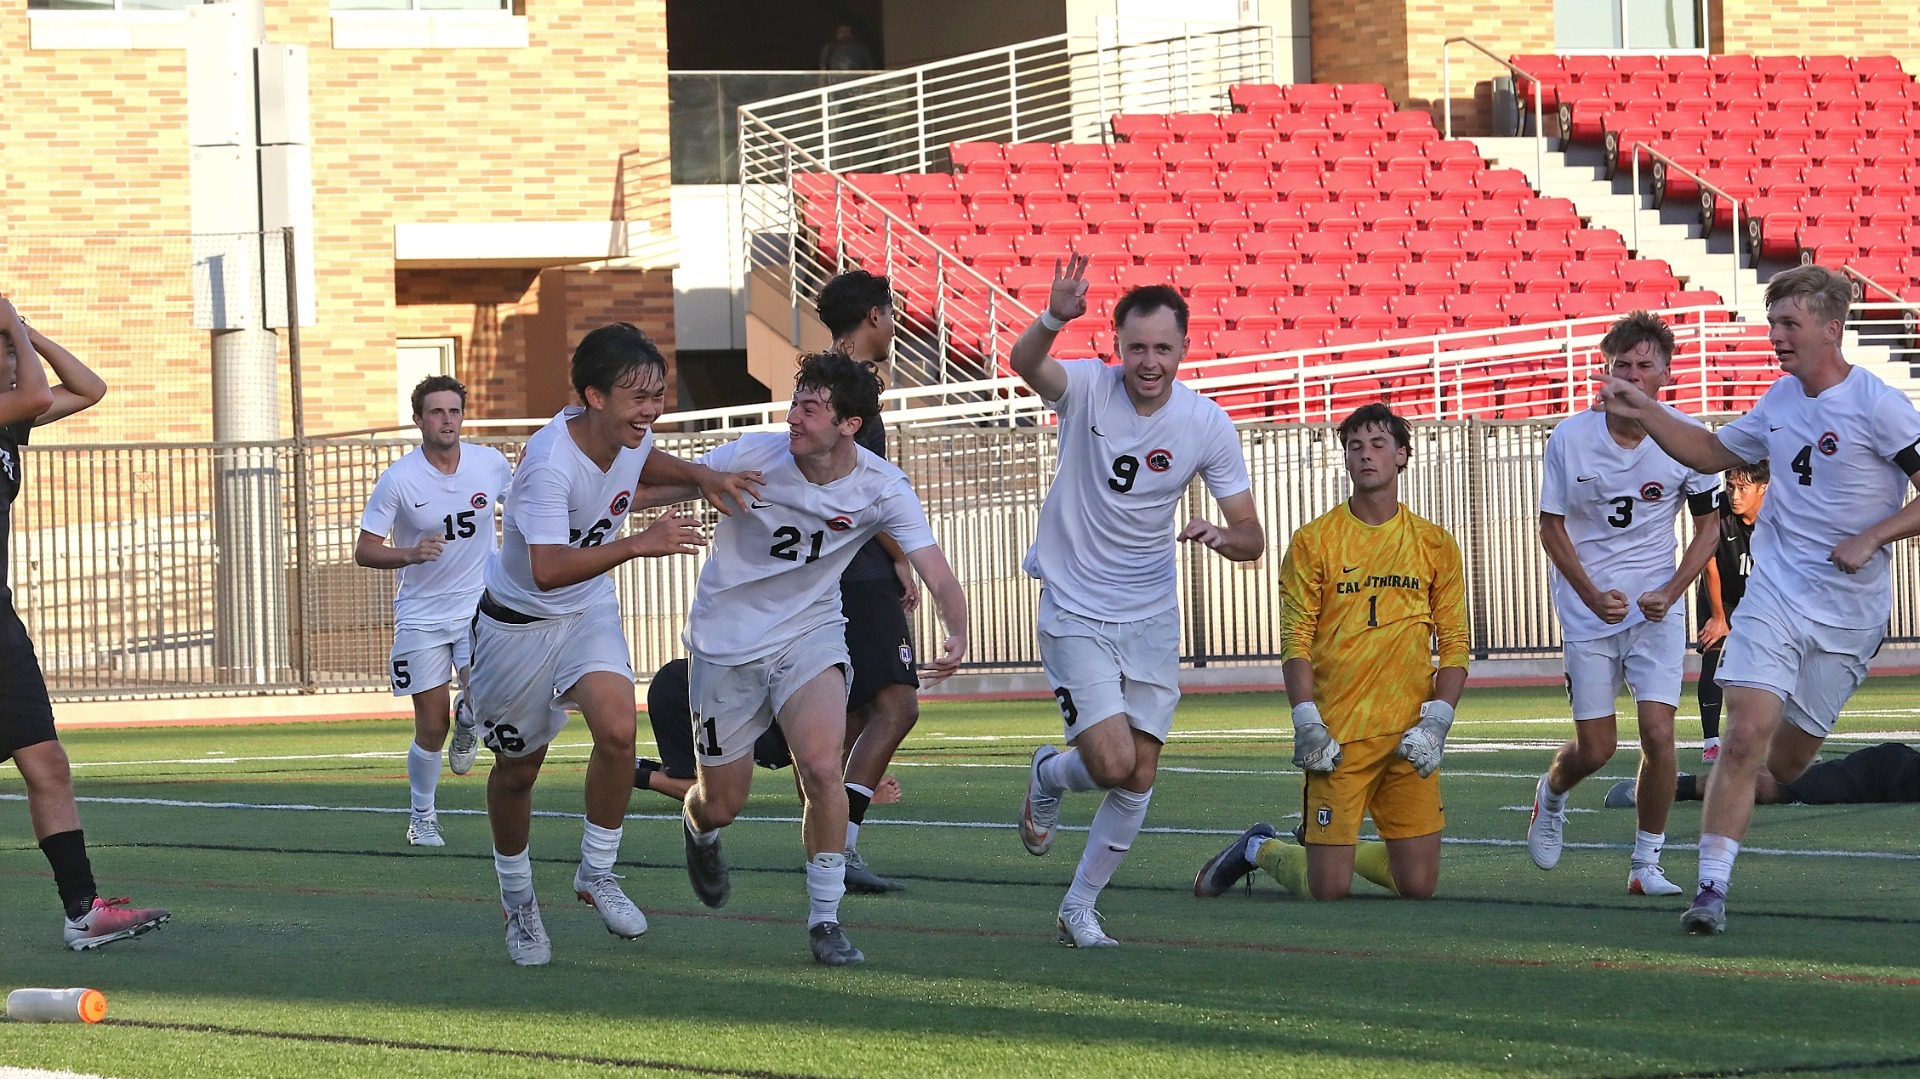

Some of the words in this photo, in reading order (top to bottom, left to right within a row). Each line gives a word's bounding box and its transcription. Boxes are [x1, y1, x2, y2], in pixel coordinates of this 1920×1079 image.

[1108, 455, 1140, 493] 9
[1791, 445, 1812, 486] 4
[443, 510, 476, 540] 15
[1608, 496, 1633, 528] 3
[770, 525, 824, 564] 21
[1336, 582, 1361, 594] CAL
[1364, 575, 1419, 590] UTHERAN
[1368, 596, 1377, 627] 1
[391, 660, 411, 689] 5
